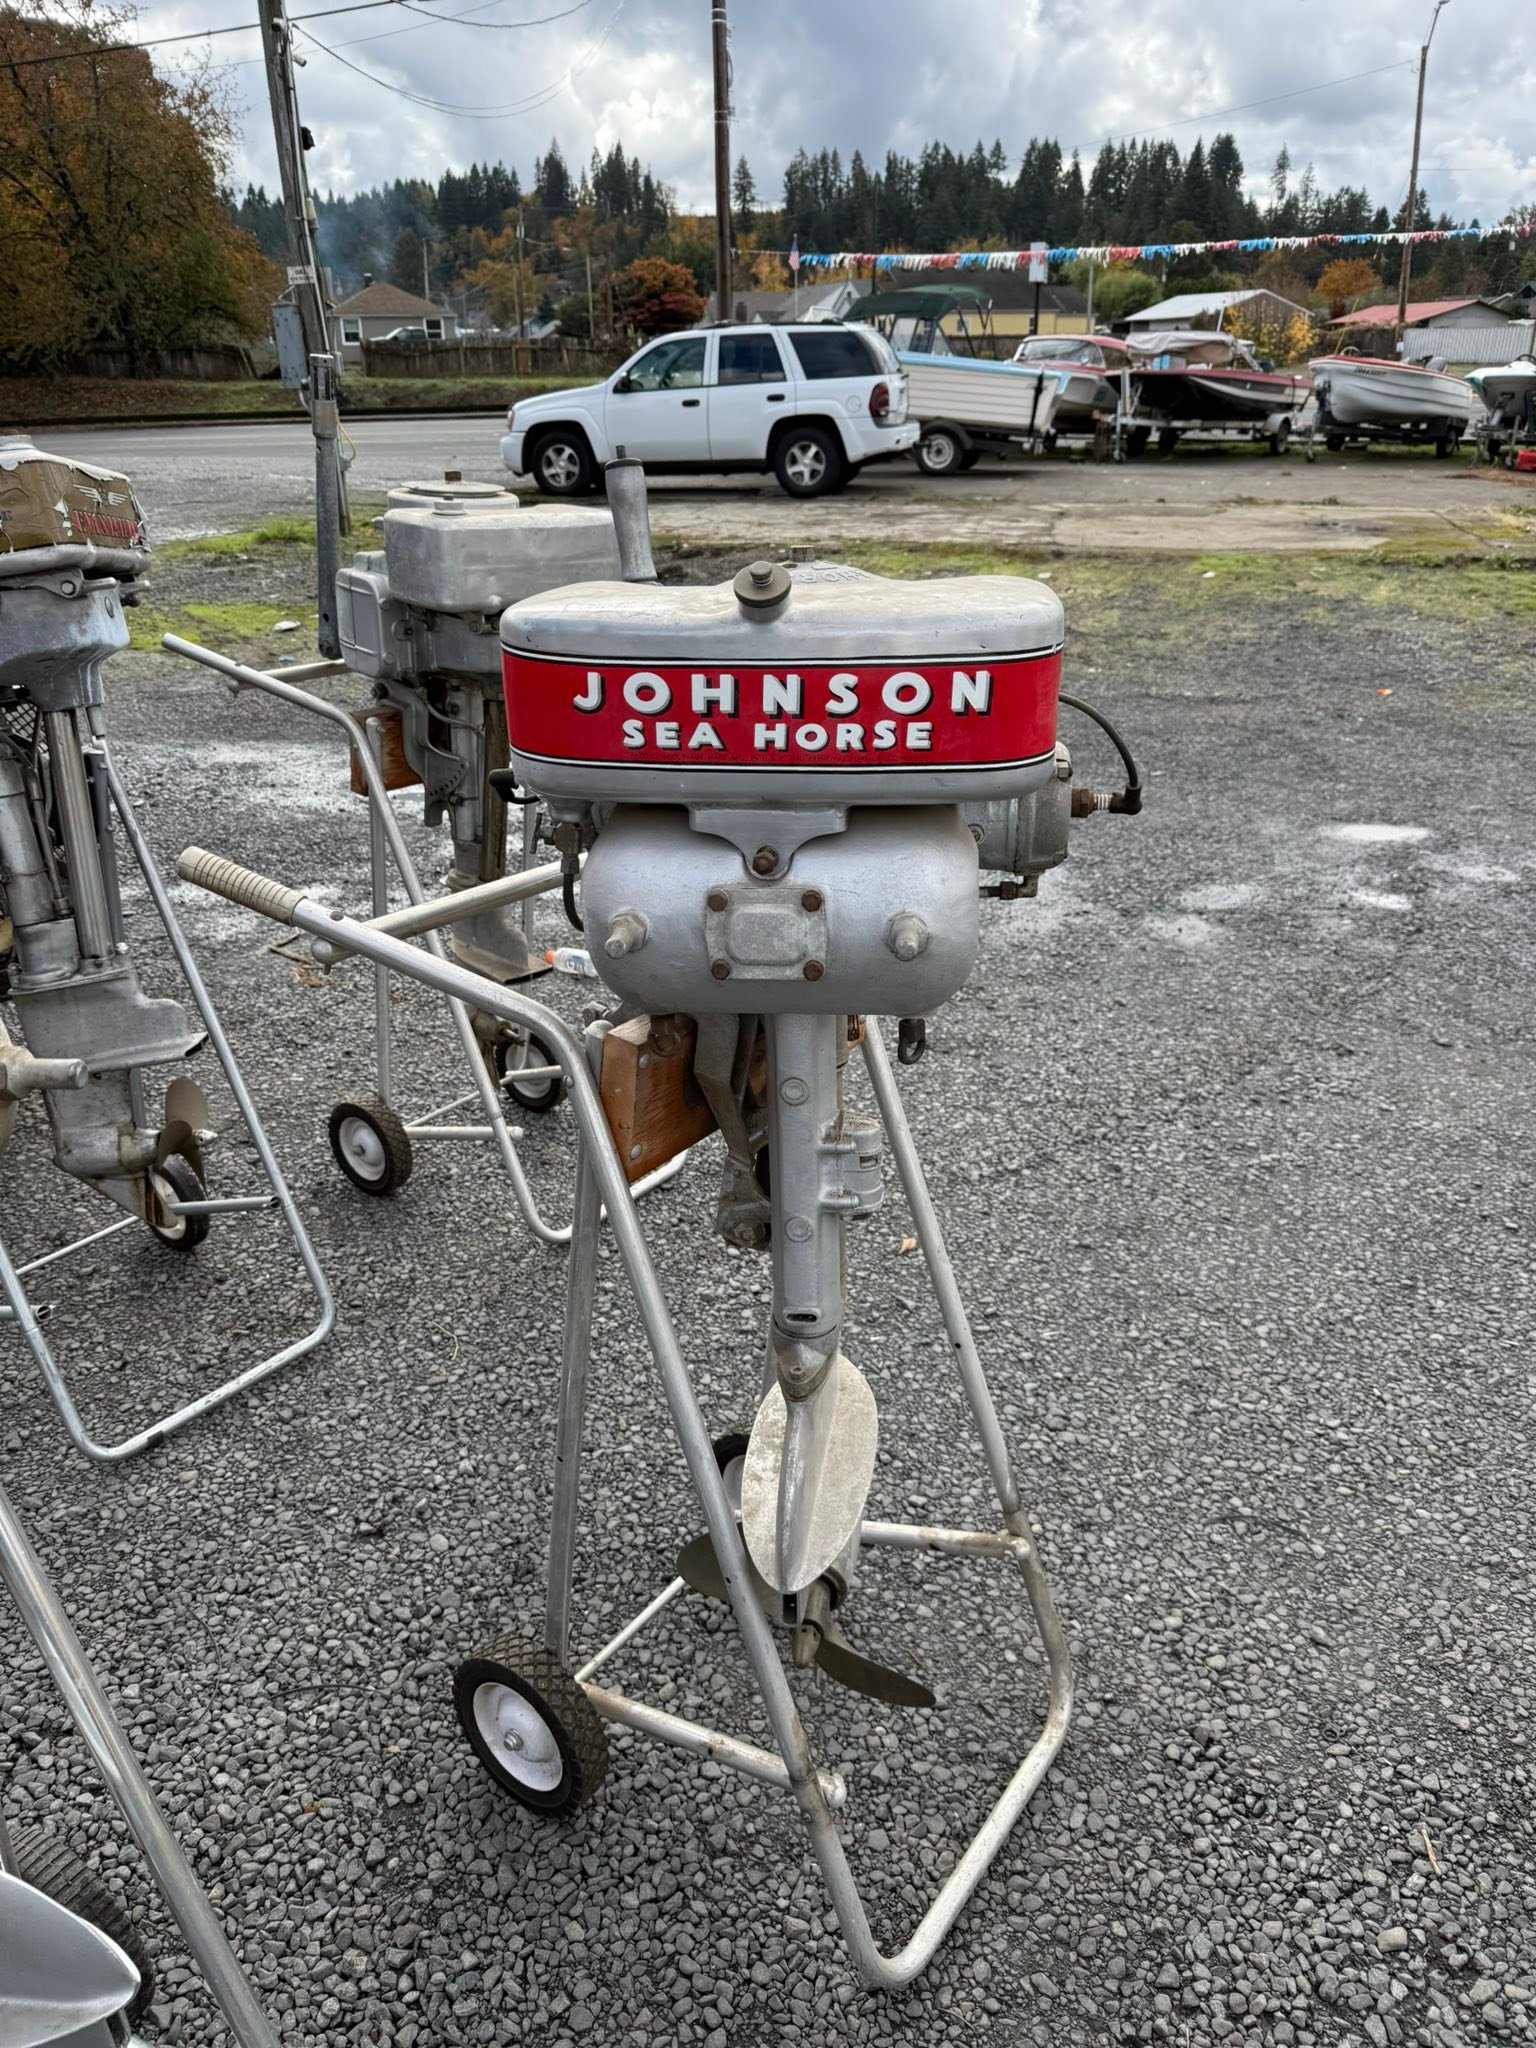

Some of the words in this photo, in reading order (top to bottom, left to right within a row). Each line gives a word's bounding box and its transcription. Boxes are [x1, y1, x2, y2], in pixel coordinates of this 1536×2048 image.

[573, 671, 993, 718] JOHNSON
[622, 719, 727, 750] SEA
[754, 720, 934, 752] HORSE
